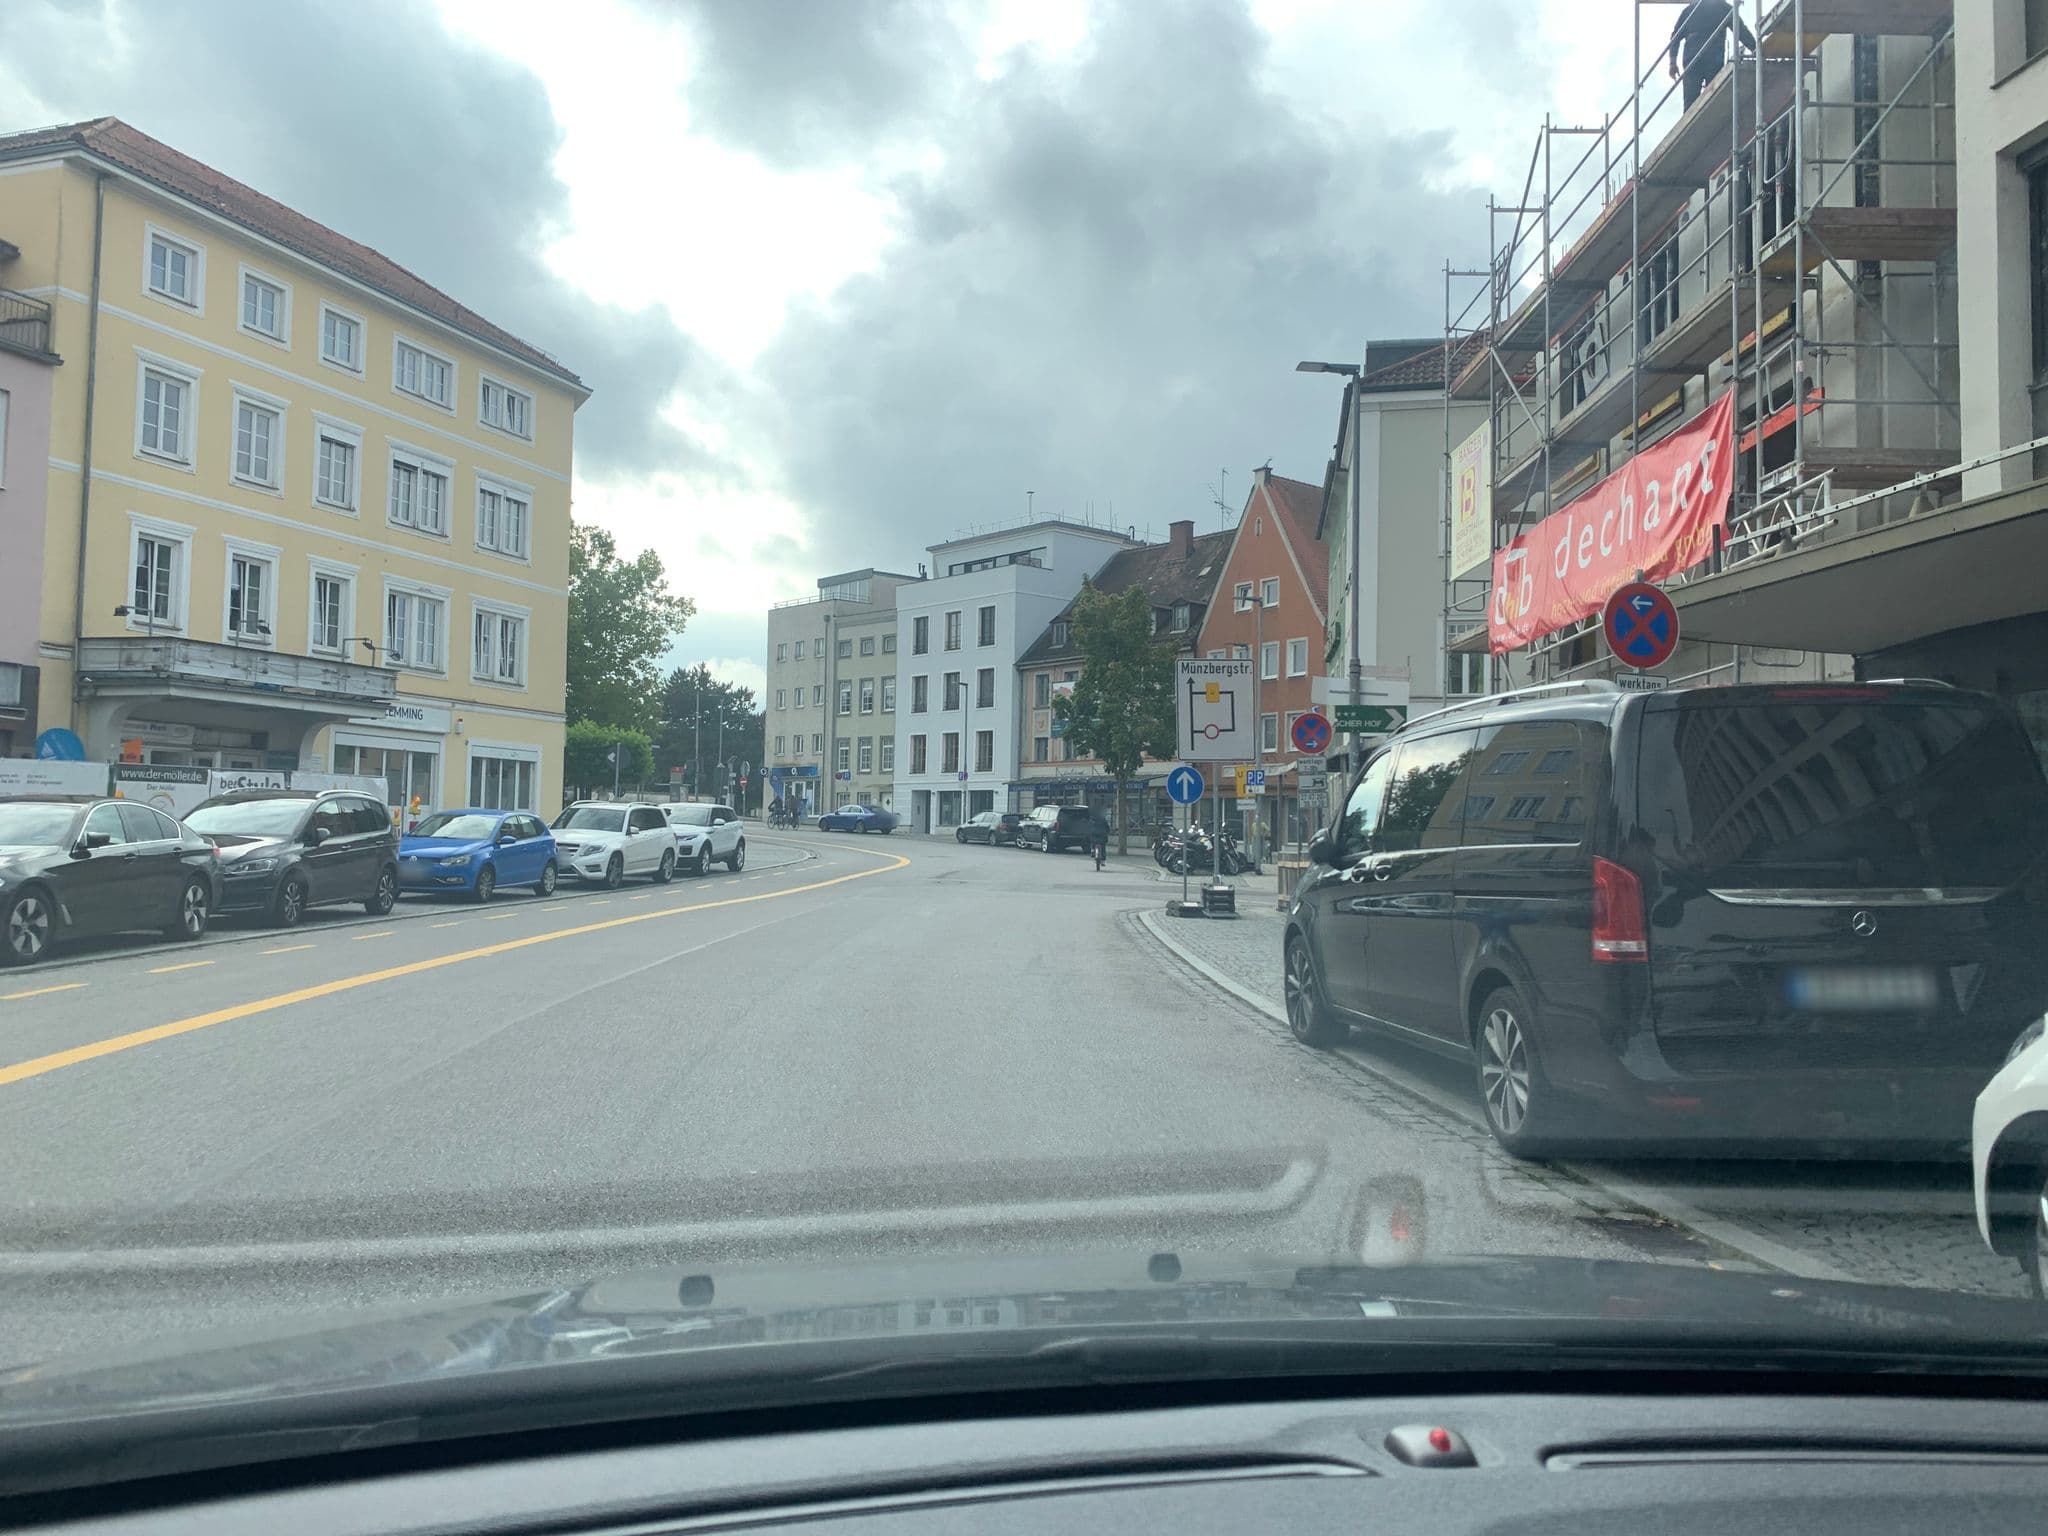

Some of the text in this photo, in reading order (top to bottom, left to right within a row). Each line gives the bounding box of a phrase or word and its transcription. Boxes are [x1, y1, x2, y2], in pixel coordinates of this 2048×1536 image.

[1554, 438, 1717, 580] dechant
[1181, 662, 1253, 677] Münzbergstr.
[121, 768, 202, 782] www.der-möller.de
